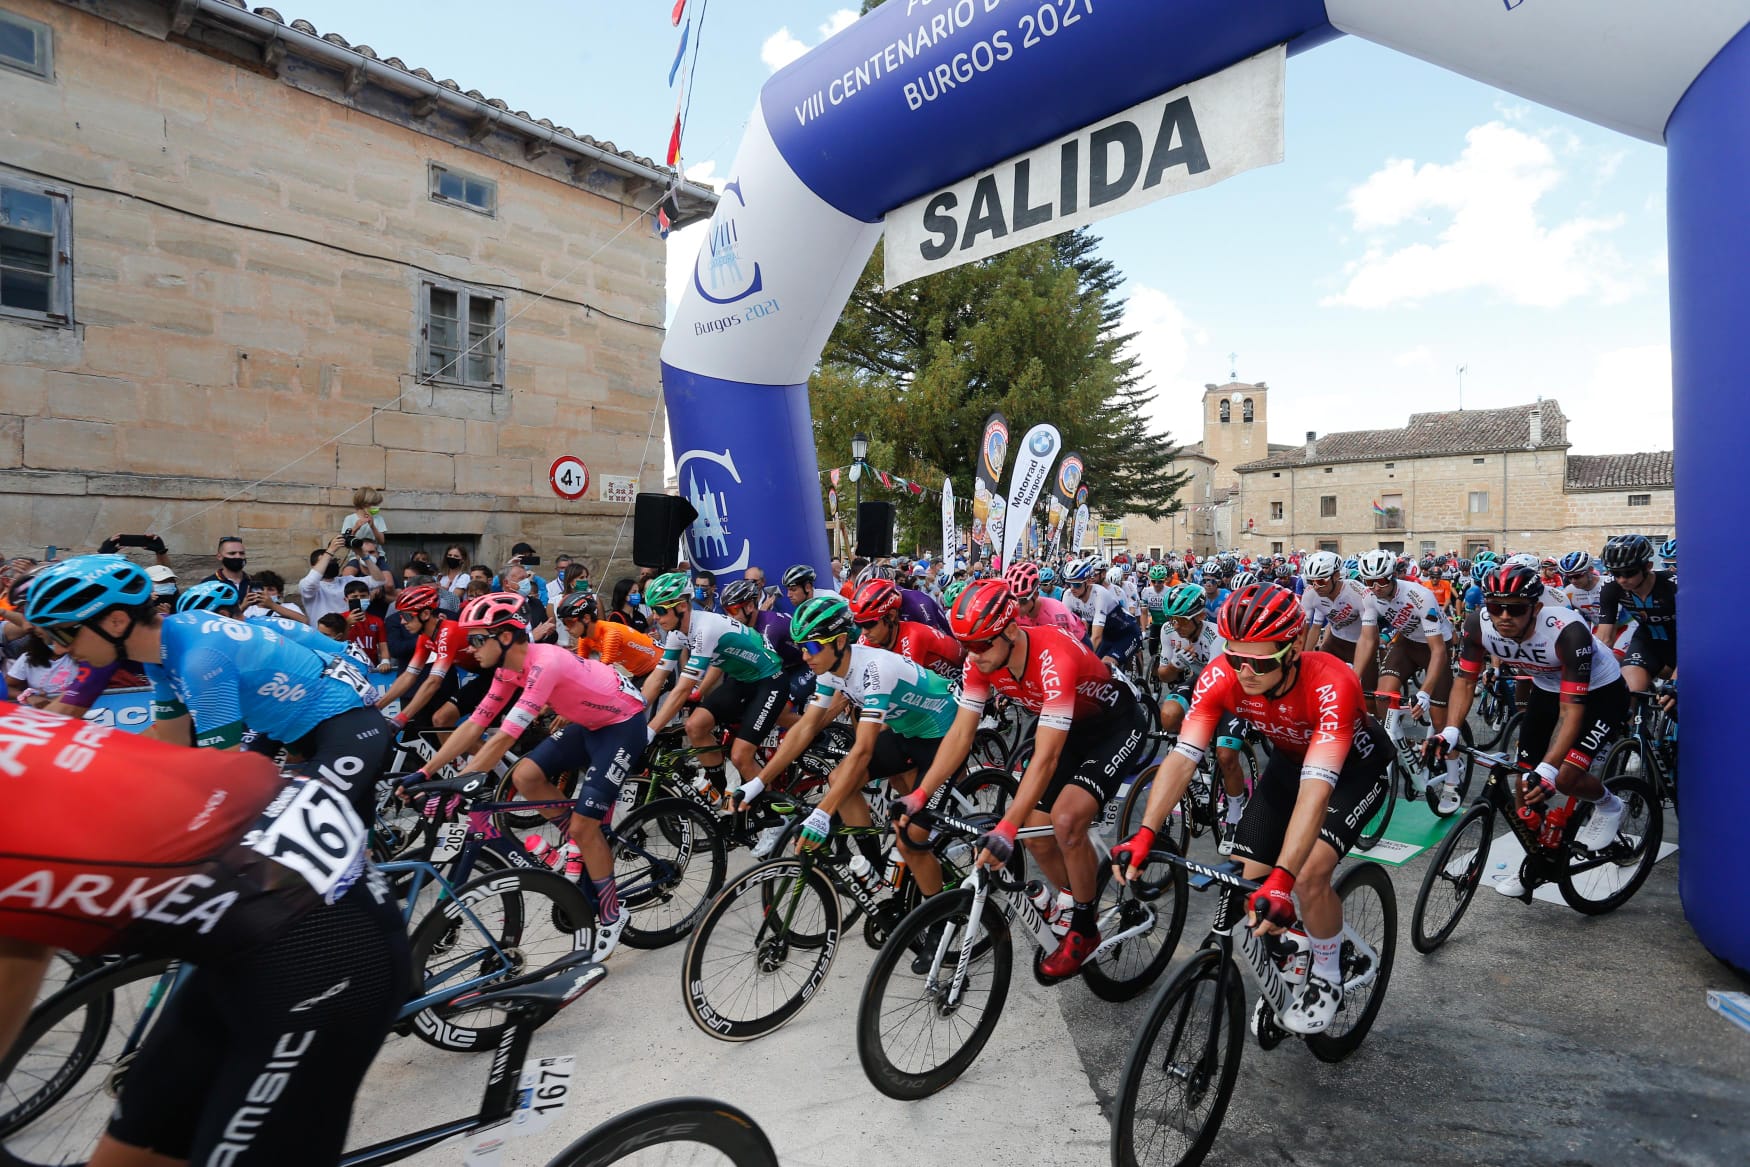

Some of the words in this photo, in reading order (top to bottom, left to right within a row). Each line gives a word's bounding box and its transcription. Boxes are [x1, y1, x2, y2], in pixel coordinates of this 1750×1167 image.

[794, 90, 825, 127] VIII
[828, 0, 976, 106] CENTENARIO
[903, 29, 1014, 112] BURGOS
[1018, 0, 1094, 48] 2021
[920, 96, 1211, 261] SALIDA
[694, 312, 742, 336] Burgos
[744, 297, 780, 321] 2021
[1010, 459, 1039, 509] Motorrad
[1023, 464, 1047, 506] Burgocar
[1039, 649, 1062, 700] ARKEA
[1491, 642, 1550, 665] UAE
[257, 672, 307, 702] eolo
[765, 690, 779, 713] RGA
[1075, 680, 1120, 707] ARKEA
[1316, 684, 1340, 745] ARKEA
[1580, 719, 1612, 751] UAE
[1104, 729, 1142, 777] SAMSIC
[622, 787, 637, 804] 52
[1105, 803, 1118, 827] 166
[1345, 781, 1384, 830] SAMSIC
[272, 786, 358, 879] 167
[443, 829, 465, 852] 205
[944, 816, 979, 836] CANYON
[735, 865, 801, 897] URSUS
[832, 862, 880, 917] uerciotti
[1185, 861, 1240, 887] CANYON
[2, 869, 241, 934] ARKEA
[801, 928, 838, 1001] URSUS
[690, 979, 733, 1035] URSUS
[206, 1029, 318, 1167] AMSIC
[533, 1069, 571, 1116] 167
